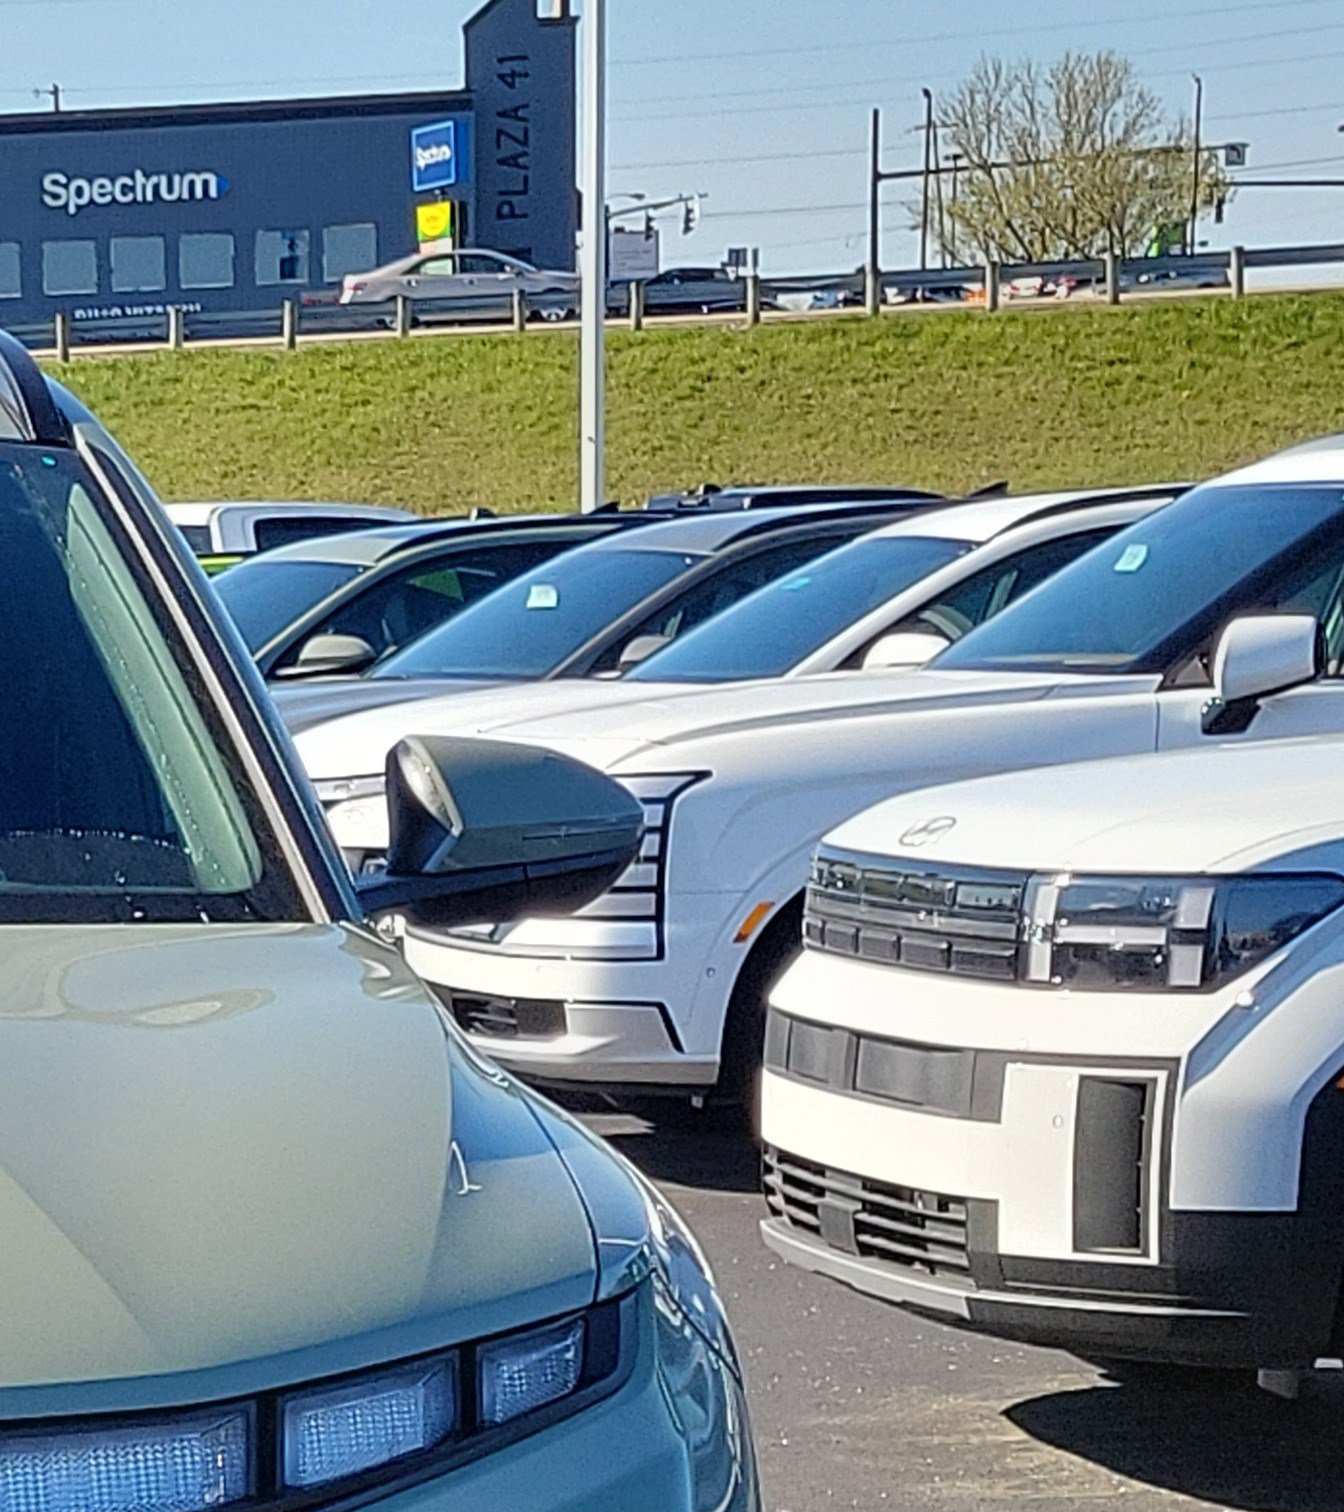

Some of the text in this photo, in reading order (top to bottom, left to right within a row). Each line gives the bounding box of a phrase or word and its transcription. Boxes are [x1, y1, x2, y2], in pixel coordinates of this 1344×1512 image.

[495, 54, 530, 221] PLAZA 41
[41, 168, 218, 216] Spectrum
